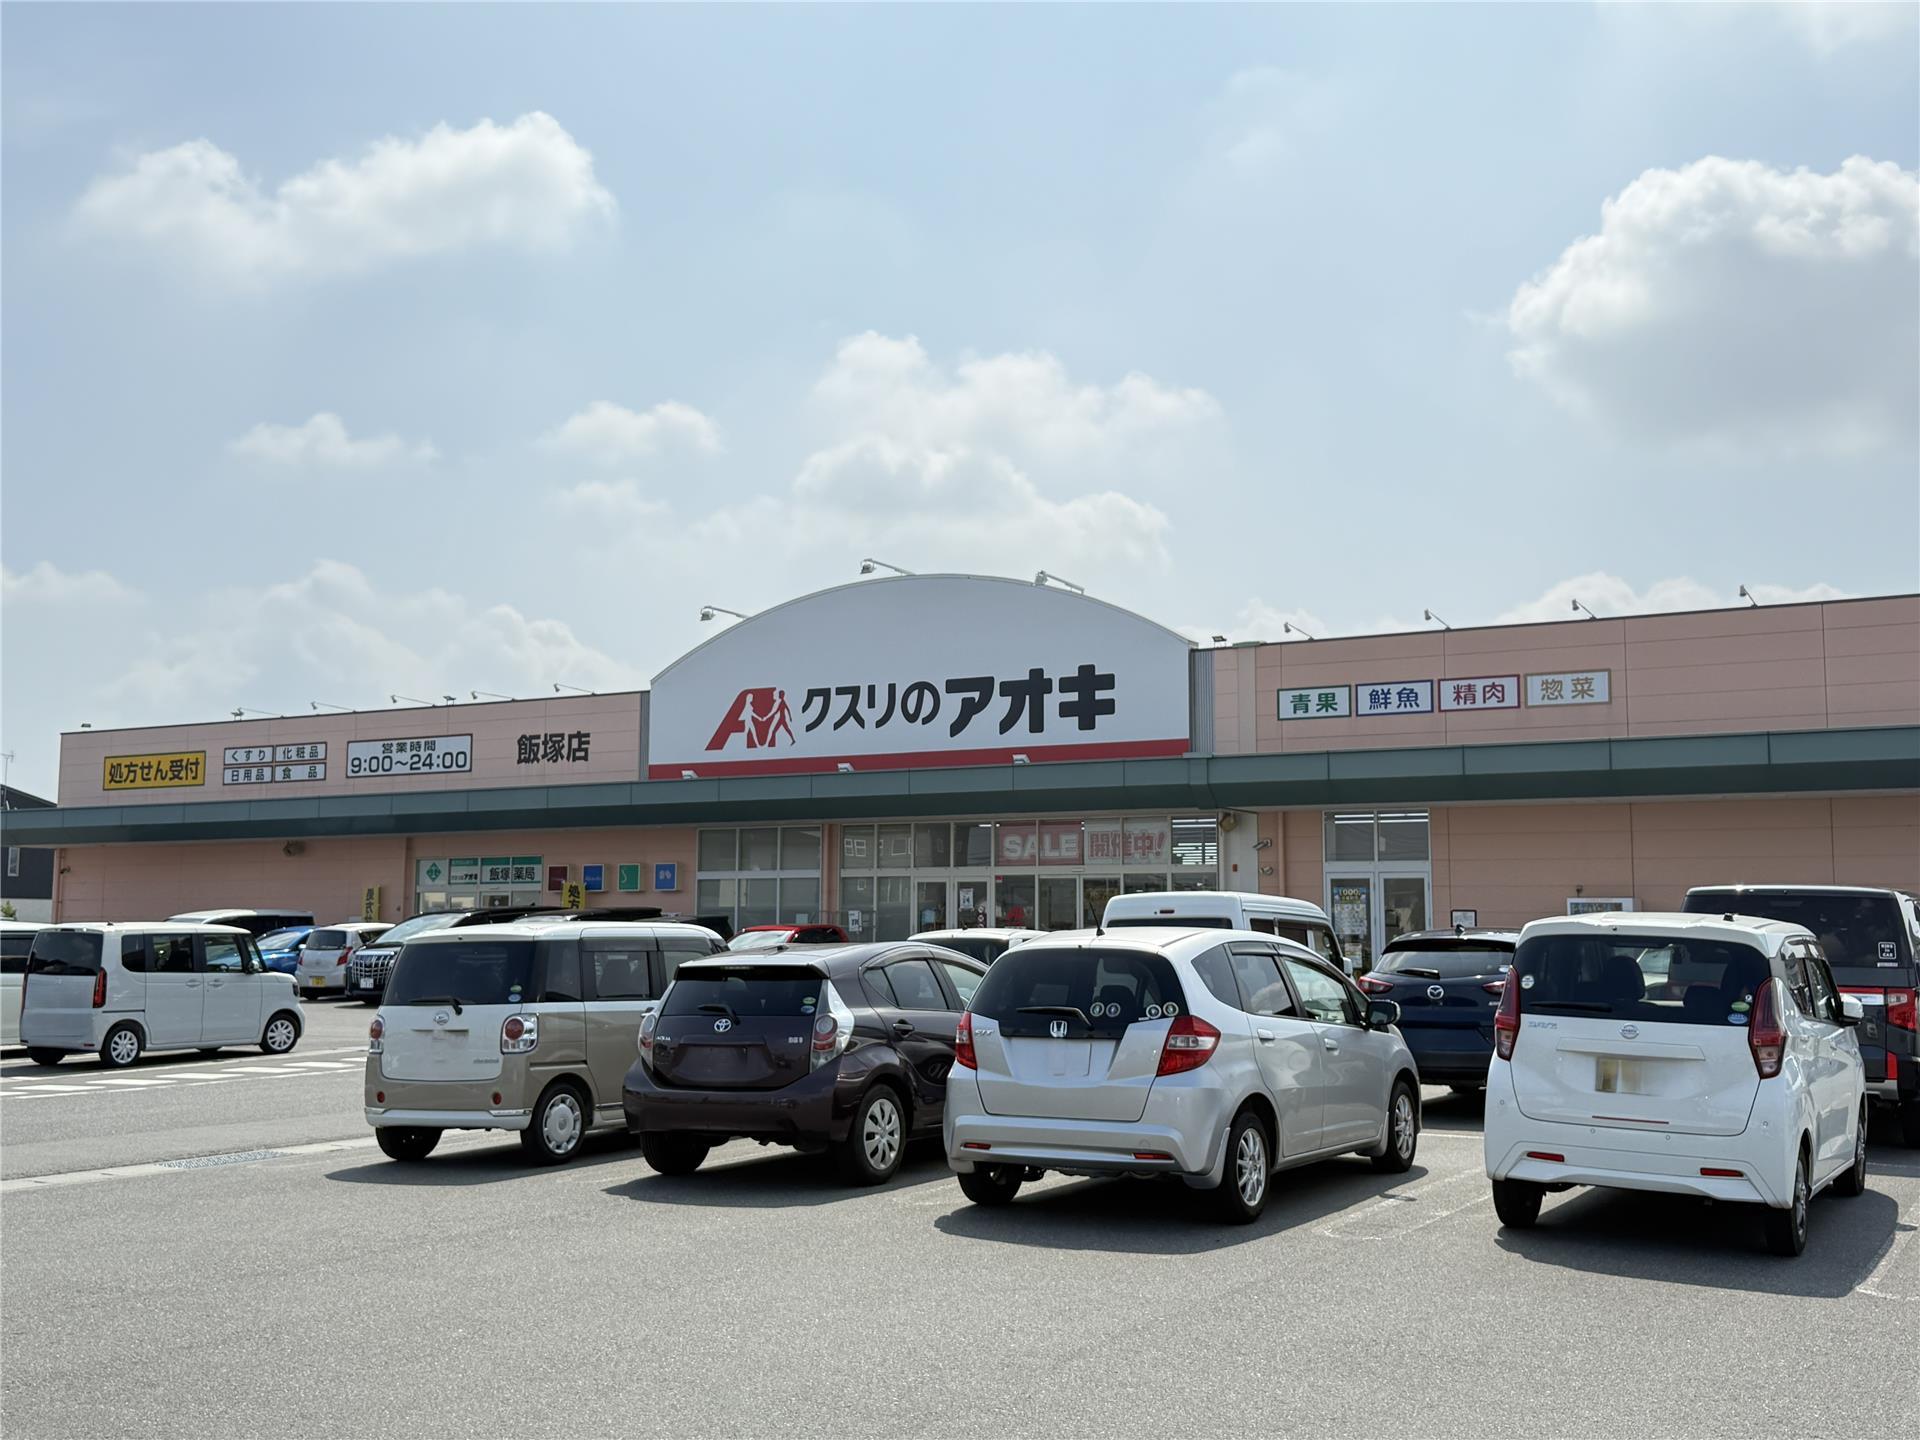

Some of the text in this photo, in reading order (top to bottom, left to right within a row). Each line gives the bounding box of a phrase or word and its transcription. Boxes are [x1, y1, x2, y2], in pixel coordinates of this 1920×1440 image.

[1368, 687, 1420, 710] 鮮魚
[1452, 682, 1505, 705] 精肉
[1540, 676, 1595, 700] 惣菜
[802, 664, 1116, 738] クスリのアオキ
[1289, 692, 1338, 714] 青果
[231, 748, 266, 762] くすり
[282, 745, 318, 759] 化粧品
[381, 740, 436, 754] 営業時間
[516, 731, 591, 765] 飯塚店
[108, 757, 200, 784] 処方せん受付
[231, 768, 265, 782] 日用品
[1003, 833, 1079, 860] SALE
[489, 866, 535, 881] 飯塚薬局
